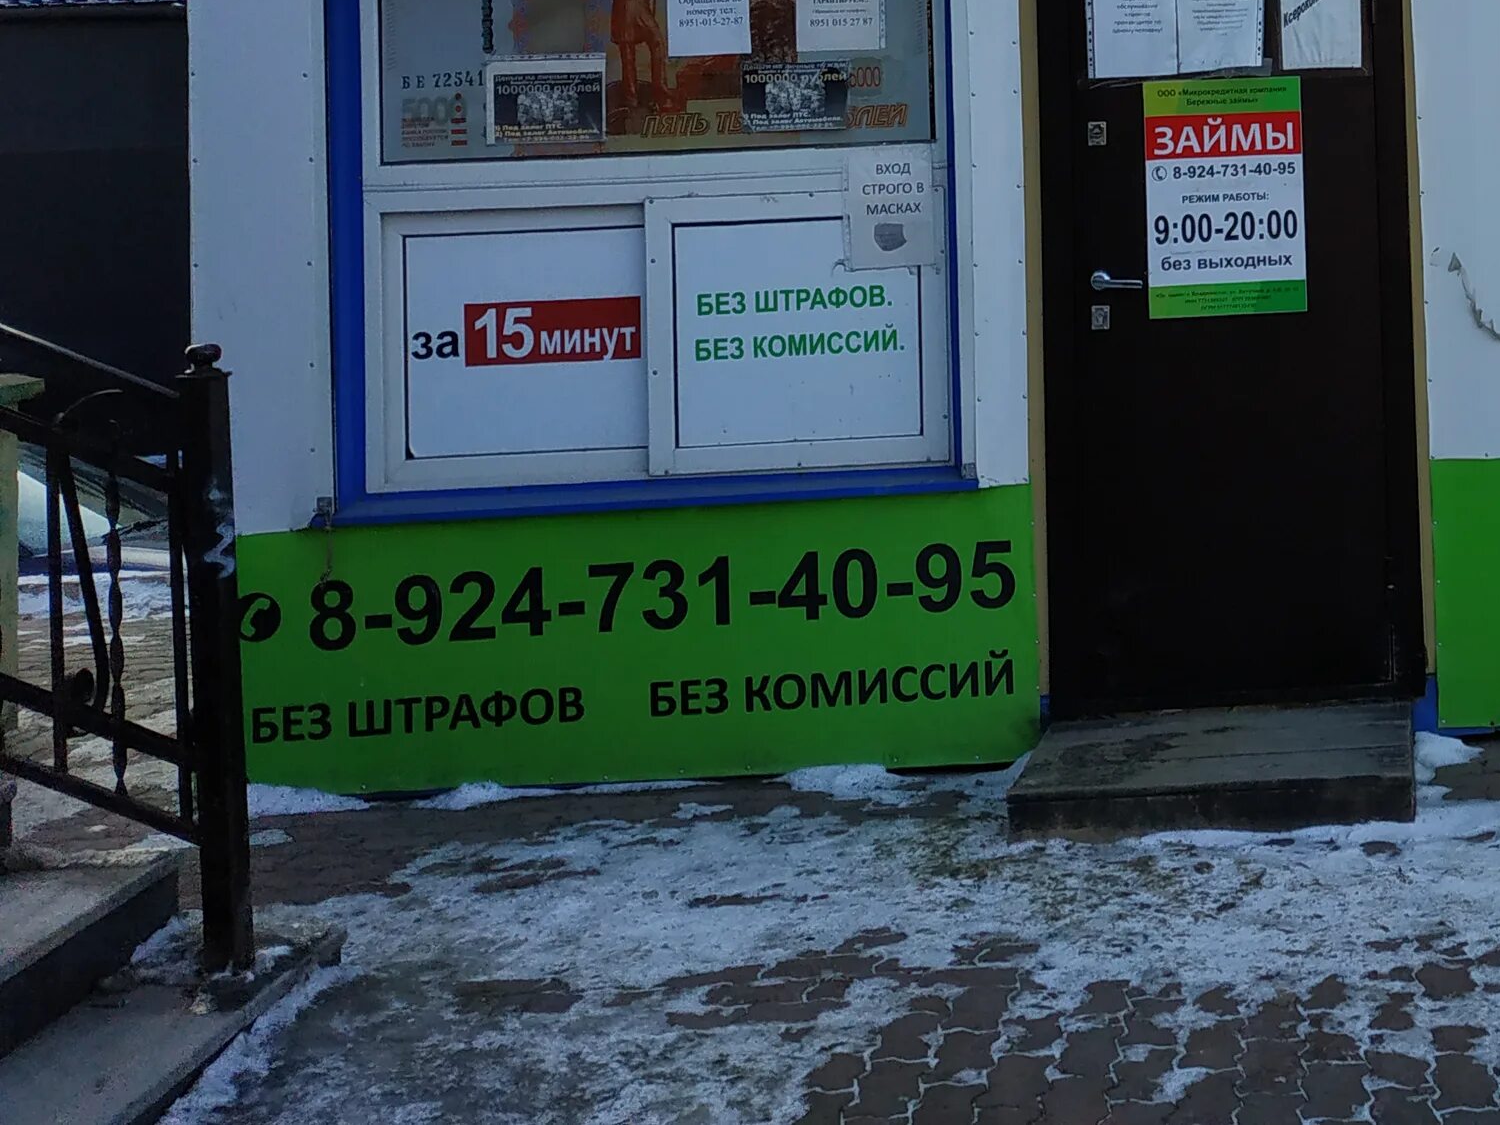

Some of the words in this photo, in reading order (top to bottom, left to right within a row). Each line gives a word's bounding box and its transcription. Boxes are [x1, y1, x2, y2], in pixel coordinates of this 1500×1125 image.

[686, 7, 717, 17] номеру
[809, 18, 829, 27] 8951
[832, 18, 848, 27] 015
[849, 18, 860, 26] 27
[744, 73, 798, 84] 1000000
[800, 71, 847, 82] рублей
[496, 84, 551, 95] 1000000
[554, 82, 601, 94] рублей
[1157, 89, 1176, 98] ООО
[641, 112, 709, 138] ПЯТЬ
[1153, 117, 1294, 155] ЗАЙМЫ
[876, 162, 911, 176] ВХОД
[1172, 162, 1296, 180] 8-924-731-40-95
[862, 182, 913, 195] СТРОГО
[916, 182, 925, 193] В
[1182, 193, 1220, 204] РЕЖИМ
[1223, 192, 1270, 202] РАБОТЫ:
[866, 202, 921, 215] МАСКАХ
[1153, 209, 1298, 245] 9:00-20:00
[1160, 256, 1192, 271] без
[1197, 254, 1293, 270] выходных
[697, 292, 746, 316] БЕЗ
[754, 284, 894, 314] ШТРАФОВ.
[411, 329, 460, 360] за
[472, 306, 535, 360] 15
[539, 324, 636, 361] минут
[694, 337, 745, 361] БЕЗ
[753, 322, 906, 359] КОМИССИЙ.
[308, 539, 1016, 651] 8-924-731-40-95
[252, 703, 333, 744] БЕЗ
[347, 686, 585, 738] ШТРАФОВ
[649, 677, 729, 717] БЕЗ
[745, 649, 1015, 713] КОМИССИЙ
